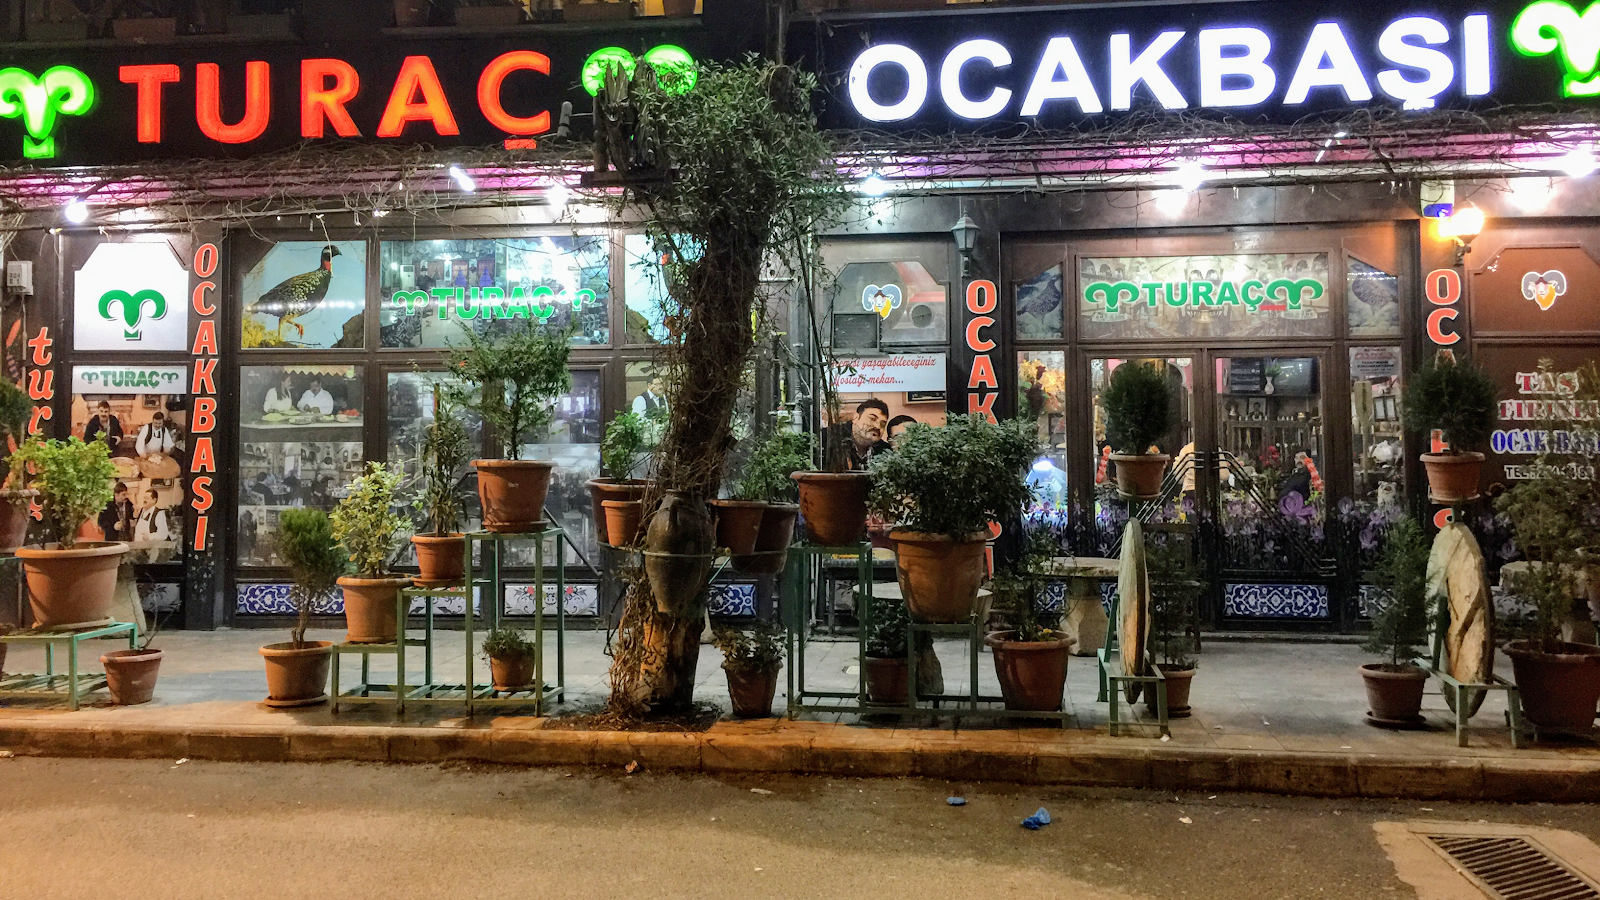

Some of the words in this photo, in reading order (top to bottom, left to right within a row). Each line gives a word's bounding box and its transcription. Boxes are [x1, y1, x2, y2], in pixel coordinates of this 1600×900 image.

[848, 13, 1490, 111] OCAKBAŞI
[118, 50, 551, 150] TURAÇ
[431, 285, 555, 324] TURAÇ
[1141, 279, 1265, 313] TURAÇ
[100, 370, 160, 389] TURAÇ
[190, 243, 219, 551] OCAKBAŞI
